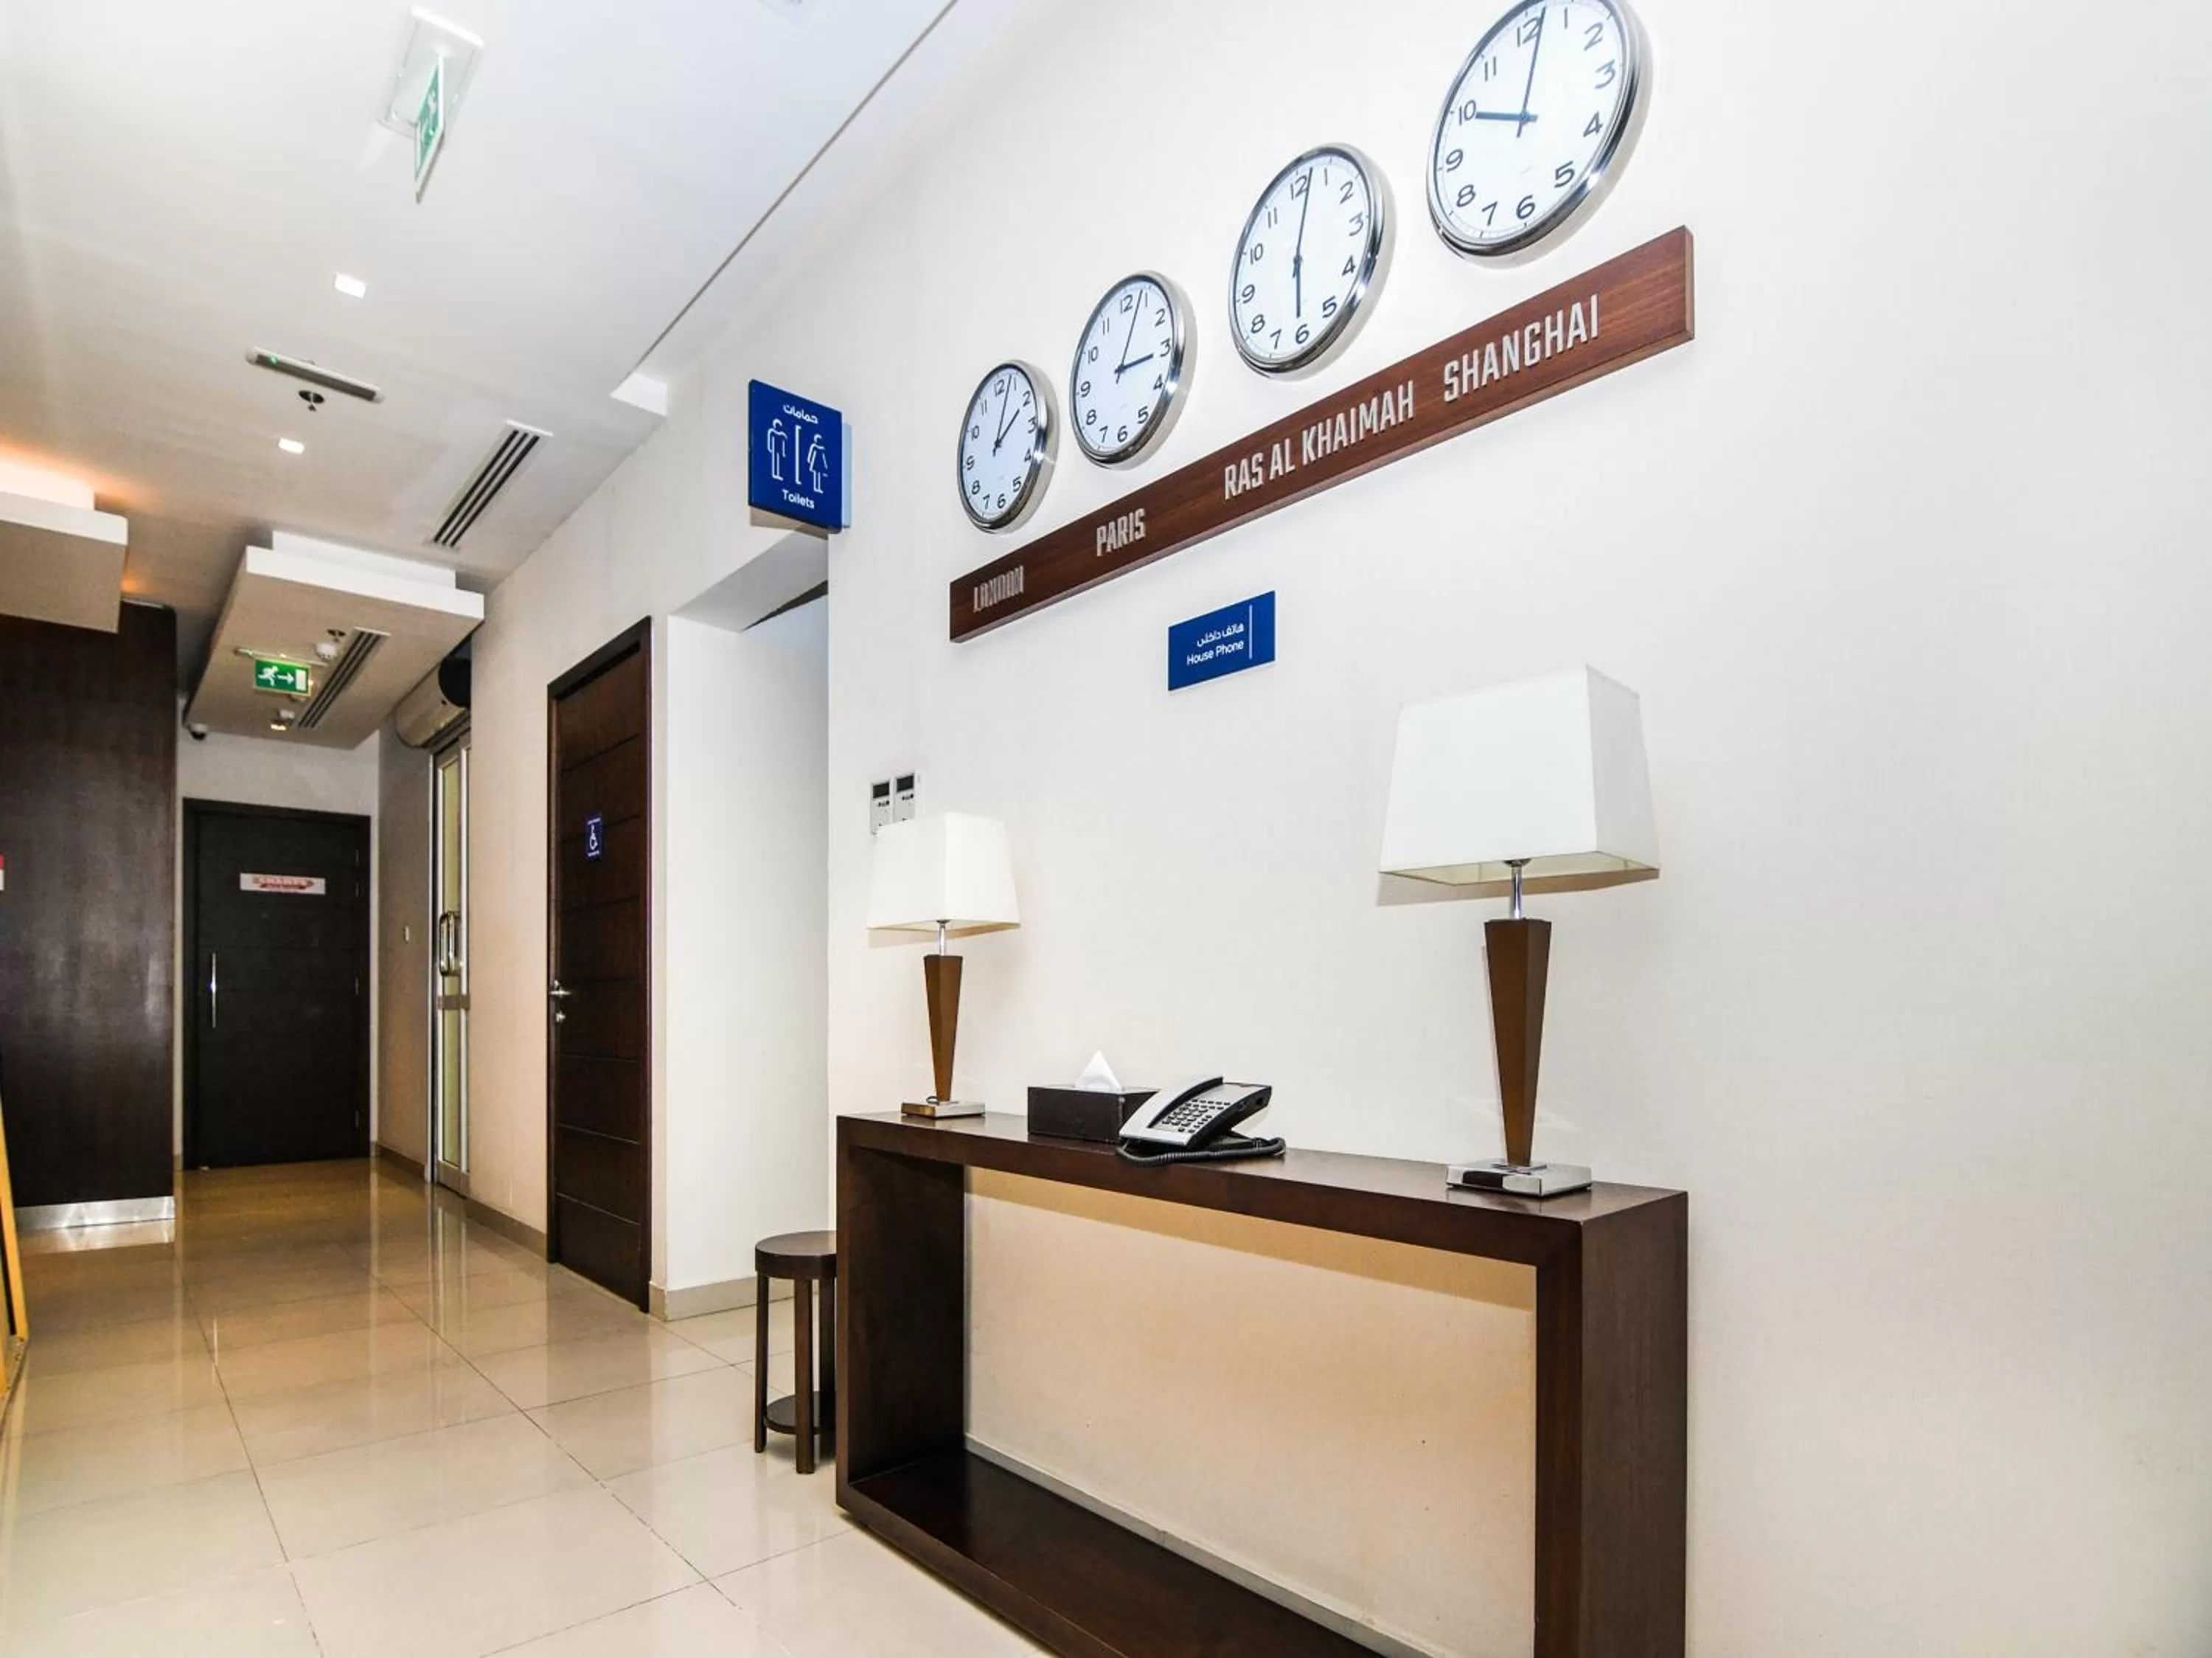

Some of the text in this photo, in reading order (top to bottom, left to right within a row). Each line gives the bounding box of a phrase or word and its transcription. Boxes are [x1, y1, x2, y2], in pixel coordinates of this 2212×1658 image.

[1516, 18, 1542, 47] 12
[1584, 22, 1604, 51] 2
[1484, 56, 1496, 82] 11
[1594, 58, 1616, 89] 3
[1458, 100, 1477, 126] 10
[1583, 111, 1603, 137] 4
[1446, 148, 1464, 173] 9
[1554, 161, 1575, 187] 5
[1290, 175, 1307, 201] 12
[1340, 181, 1354, 204] 2
[1456, 184, 1476, 207] 8
[1482, 201, 1498, 226] 7
[1516, 195, 1536, 220] 6
[1267, 207, 1278, 229] 11
[1349, 212, 1364, 237] 3
[1250, 243, 1264, 265] 10
[1341, 255, 1356, 277] 4
[1120, 294, 1133, 314] 12
[1241, 284, 1256, 304] 9
[1154, 308, 1166, 327] 2
[1322, 296, 1338, 319] 5
[1102, 316, 1110, 335] 11
[1251, 313, 1266, 334] 8
[1270, 329, 1282, 350] 7
[1295, 324, 1310, 344] 6
[1088, 346, 1099, 364] 10
[1160, 339, 1171, 358] 3
[1444, 294, 1599, 403] SHANGHAI
[994, 380, 1005, 397] 12
[1080, 381, 1091, 398] 9
[1152, 373, 1164, 390] 4
[981, 399, 987, 416] 11
[1023, 391, 1031, 407] 2
[782, 404, 818, 424] حمامات
[1086, 409, 1096, 426] 8
[1137, 406, 1149, 424] 5
[971, 425, 980, 440] 10
[1028, 417, 1036, 434] 3
[1099, 426, 1108, 443] 7
[1117, 426, 1128, 443] 6
[1225, 380, 1414, 500] RAS AL KHAIMAH
[966, 455, 975, 471] 9
[1024, 448, 1032, 462] 4
[972, 479, 981, 495] 8
[1012, 476, 1021, 493] 5
[782, 489, 815, 509] Toilets
[983, 494, 990, 510] 7
[997, 493, 1006, 509] 6
[1096, 507, 1146, 557] PARIS
[1222, 622, 1245, 638] هاتف
[1186, 640, 1245, 666] House Phone
